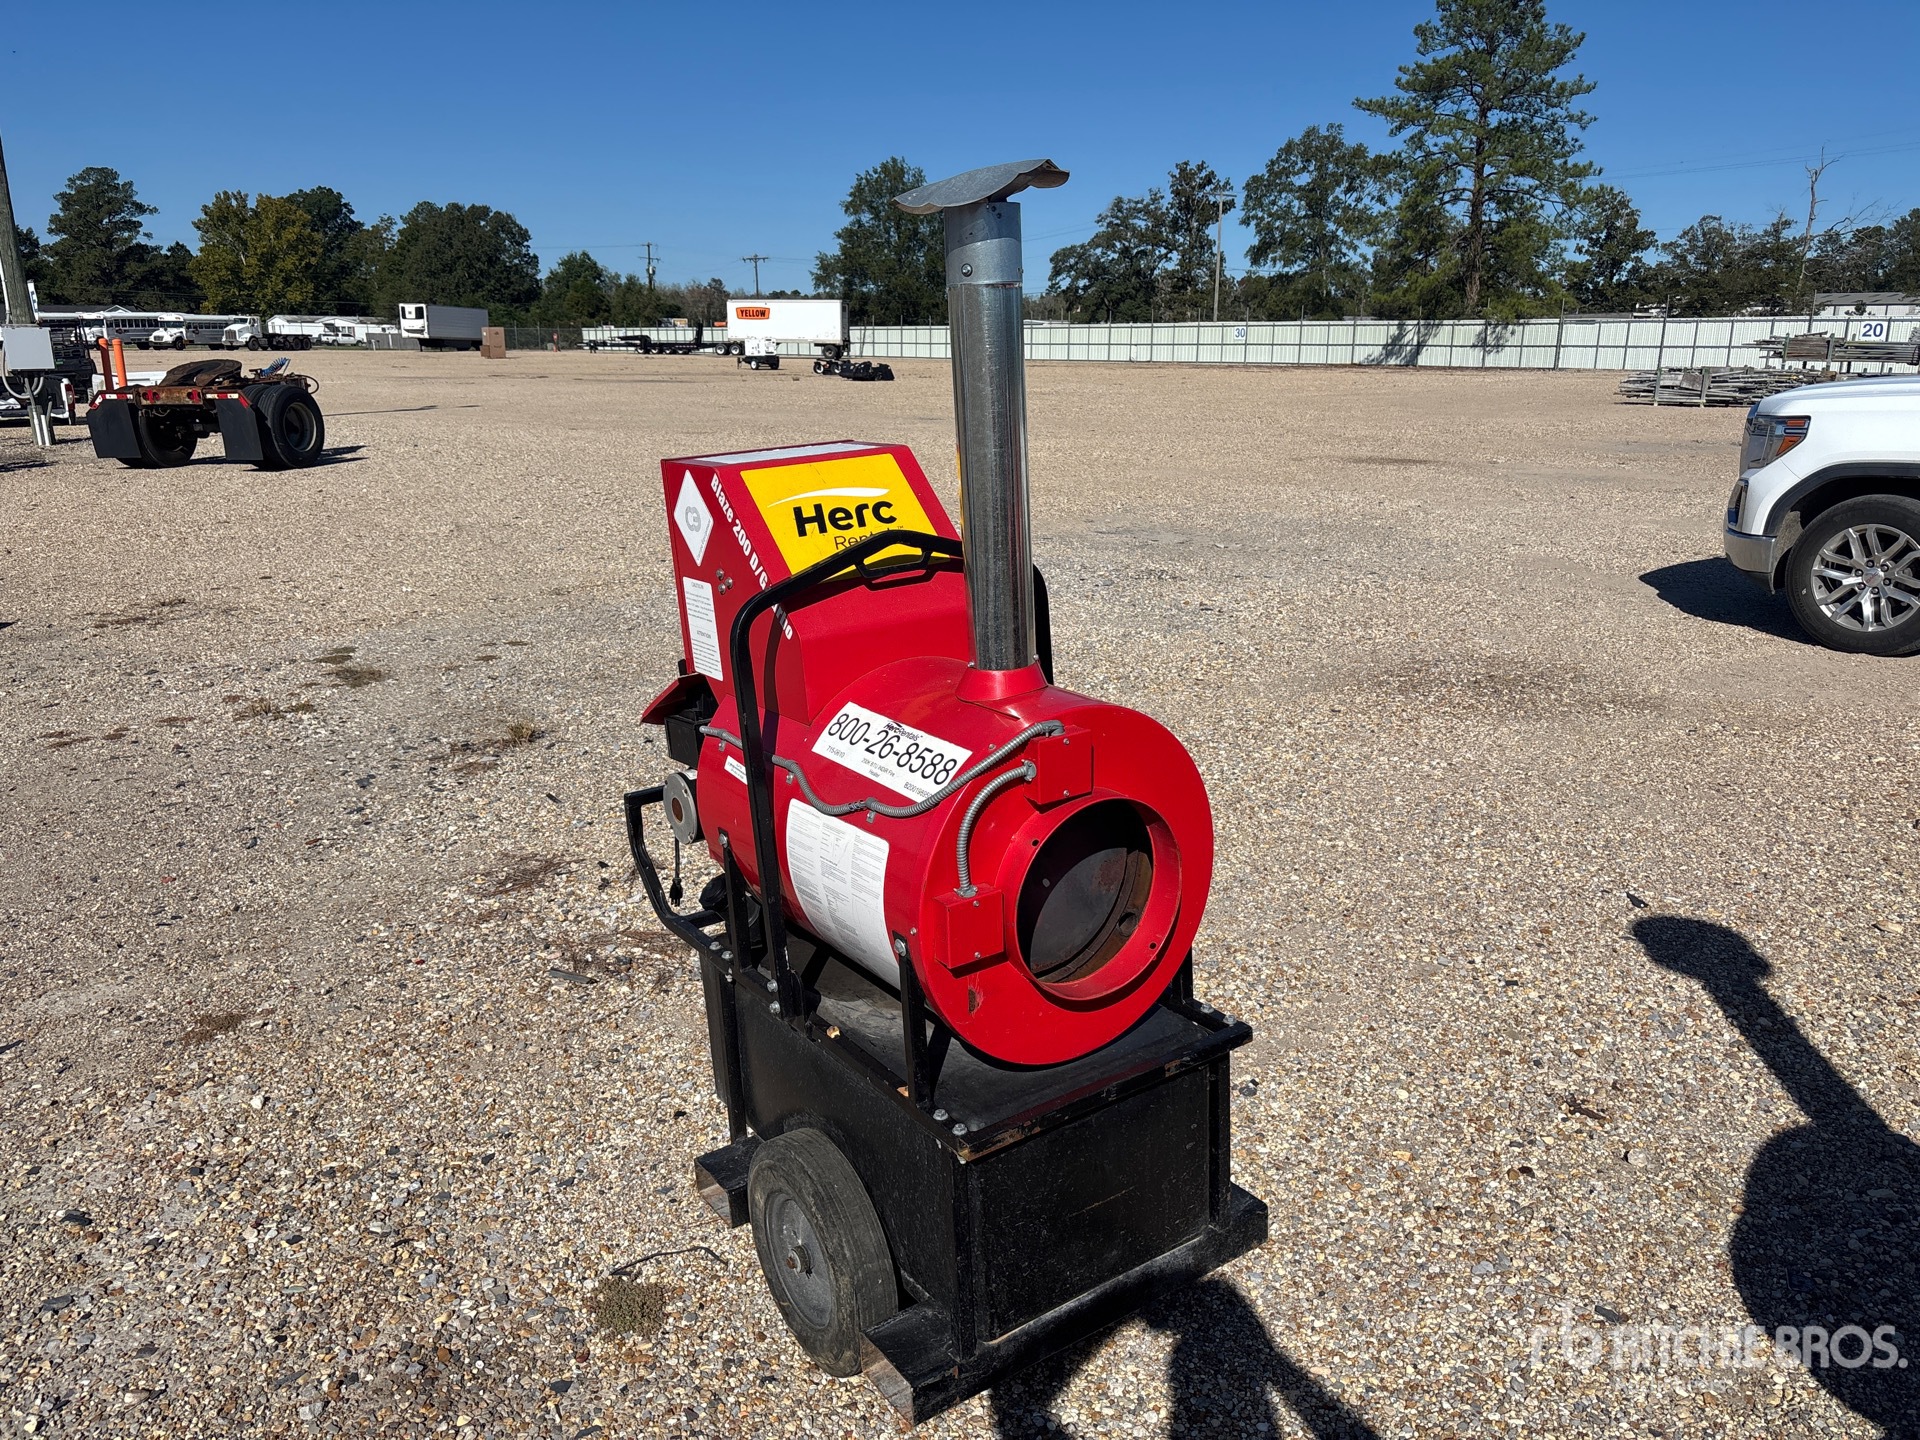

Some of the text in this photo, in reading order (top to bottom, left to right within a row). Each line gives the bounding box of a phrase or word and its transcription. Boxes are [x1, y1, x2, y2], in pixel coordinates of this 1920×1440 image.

[740, 309, 767, 318] YELLOW
[1235, 328, 1246, 338] 30
[1862, 323, 1884, 337] 20
[710, 472, 734, 523] Blaze
[732, 519, 752, 557] 200
[749, 551, 768, 591] D/G
[793, 501, 897, 537] Herc
[828, 713, 957, 785] 800-26-8588
